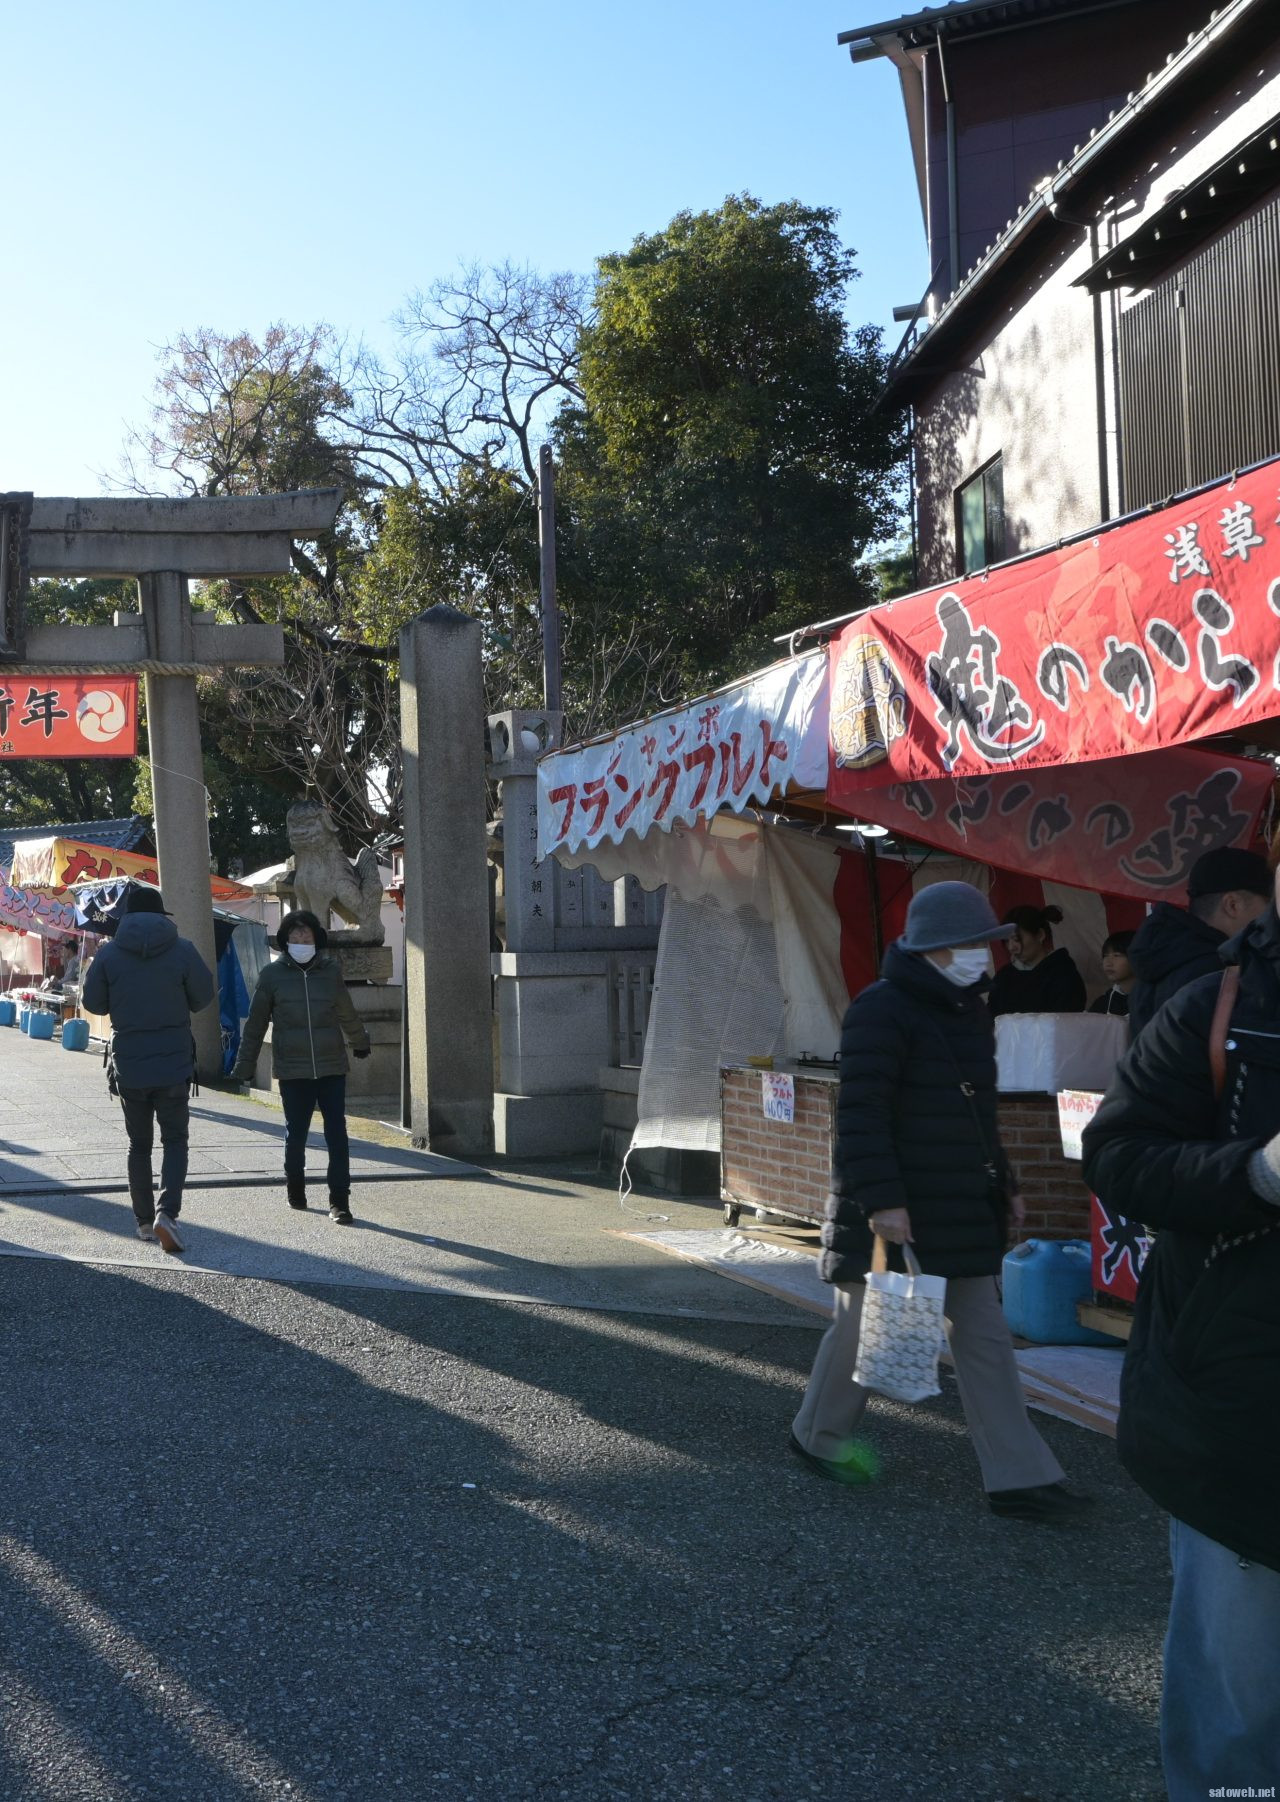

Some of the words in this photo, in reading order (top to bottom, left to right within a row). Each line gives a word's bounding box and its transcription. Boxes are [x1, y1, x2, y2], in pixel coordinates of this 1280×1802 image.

[1163, 490, 1280, 584] 浅草
[925, 577, 1280, 771] 鬼のから
[548, 720, 789, 842] フランクフルト
[606, 703, 720, 776] ジャンボ
